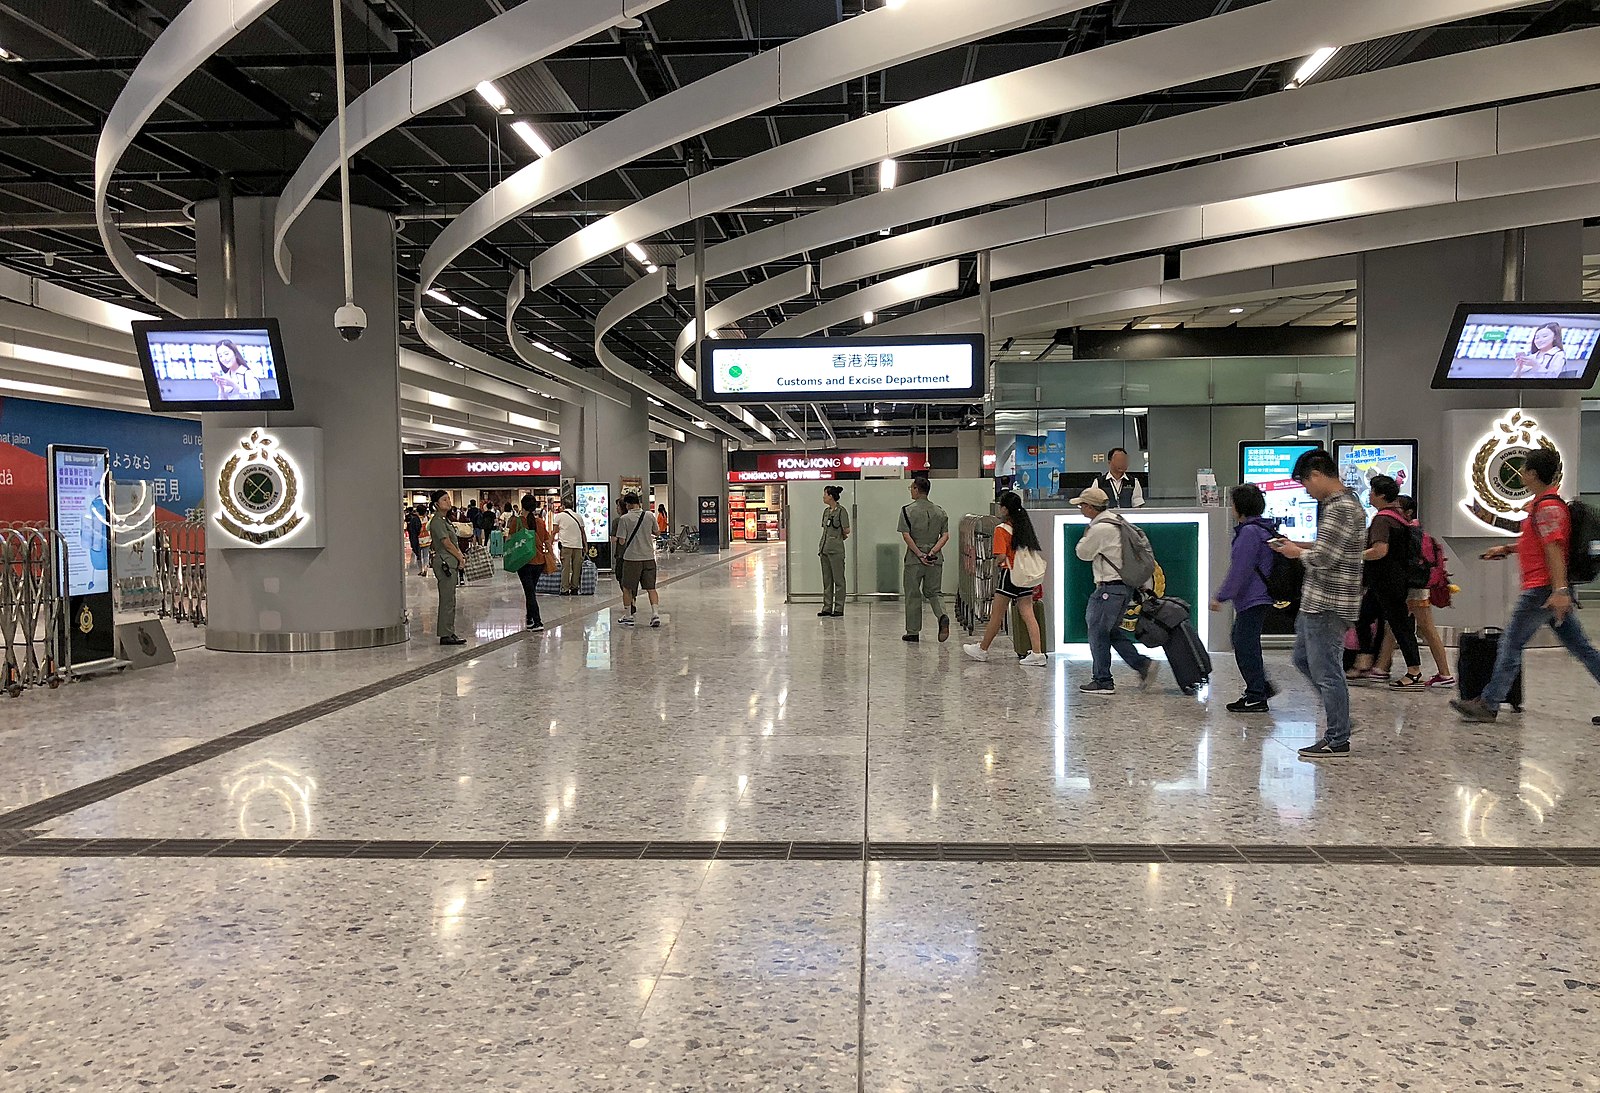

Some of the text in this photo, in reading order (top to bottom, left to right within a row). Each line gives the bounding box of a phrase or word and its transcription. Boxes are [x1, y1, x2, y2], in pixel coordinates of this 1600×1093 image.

[832, 353, 894, 368] 香港海關
[776, 374, 950, 386] Customs and Excise Department
[11, 433, 31, 446] jalan
[182, 434, 193, 445] au
[112, 452, 151, 470] ようなら
[1500, 450, 1517, 460] HONG
[467, 461, 500, 472] HONG
[500, 461, 531, 472] KONG
[777, 458, 810, 469] HONG
[810, 457, 841, 468] KONG
[242, 466, 274, 476] HONG KONG
[154, 478, 181, 502] 再見
[1493, 476, 1514, 496] CUSTOMS
[237, 491, 256, 510] CUSTOMS
[266, 491, 279, 508] EXCISE
